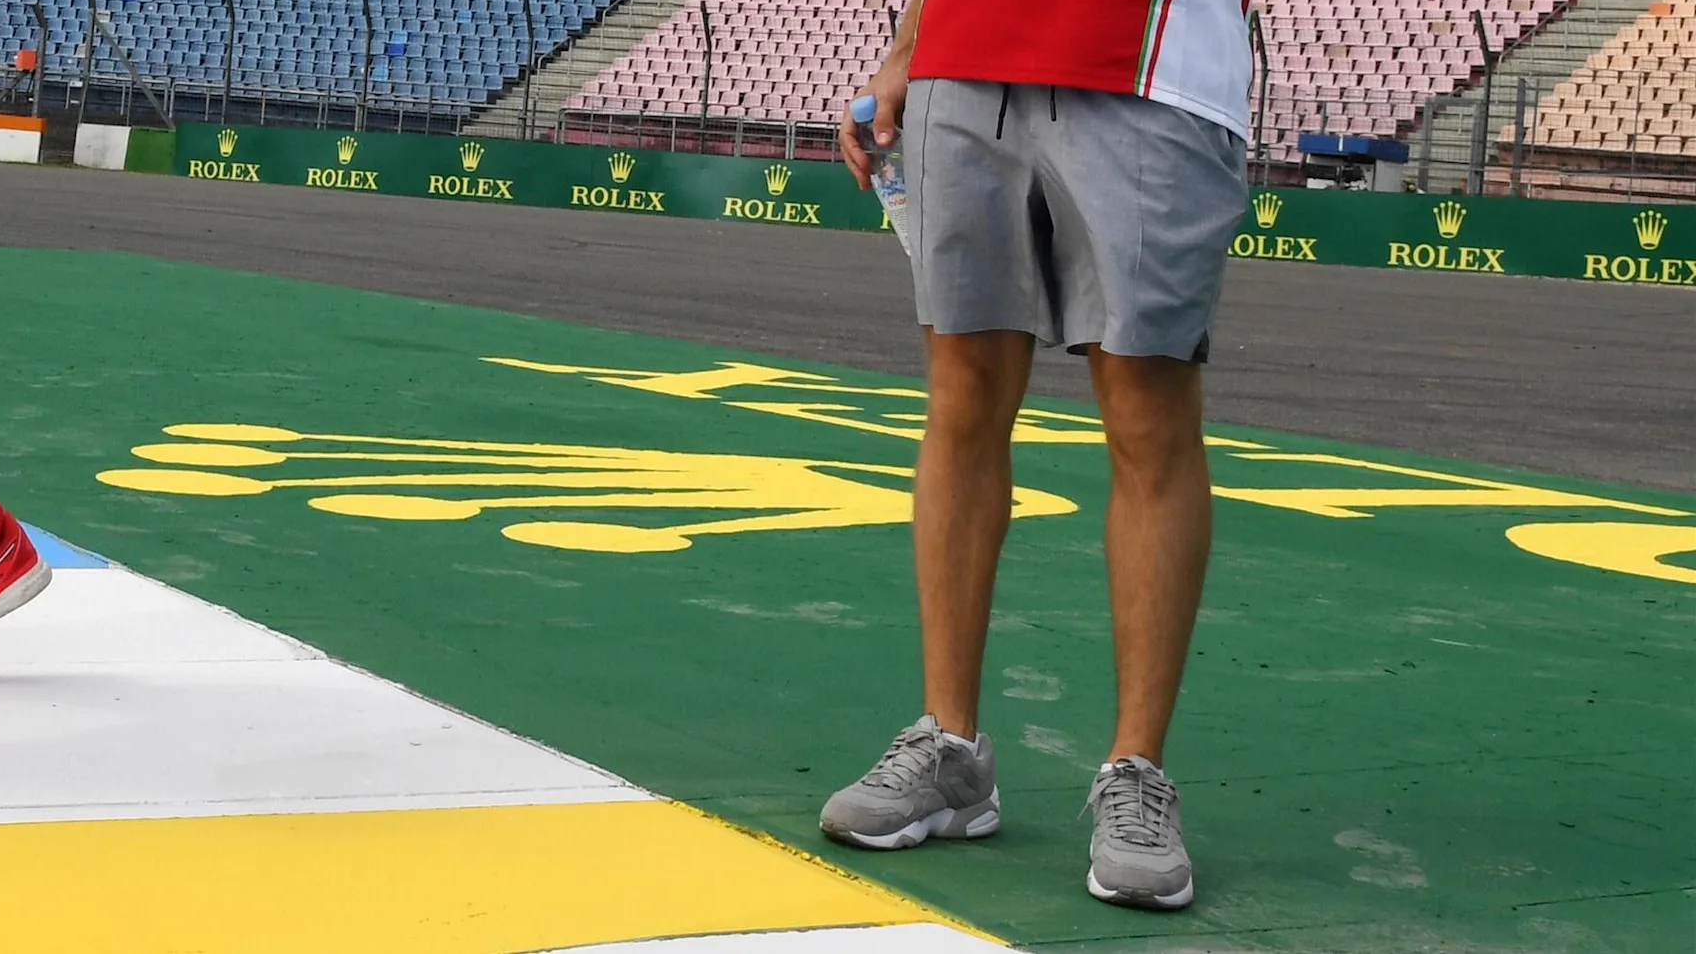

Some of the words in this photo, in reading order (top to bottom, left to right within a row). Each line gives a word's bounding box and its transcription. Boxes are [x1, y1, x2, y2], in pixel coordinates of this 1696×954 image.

[190, 160, 258, 182] ROLEX
[308, 169, 376, 190] ROLEX
[430, 176, 510, 199] ROLEX
[572, 187, 662, 211] ROLEX
[726, 198, 818, 223] ROLEX
[1228, 233, 1317, 260] OLEX
[1389, 242, 1504, 273] ROLEX
[1583, 254, 1696, 284] ROLEX
